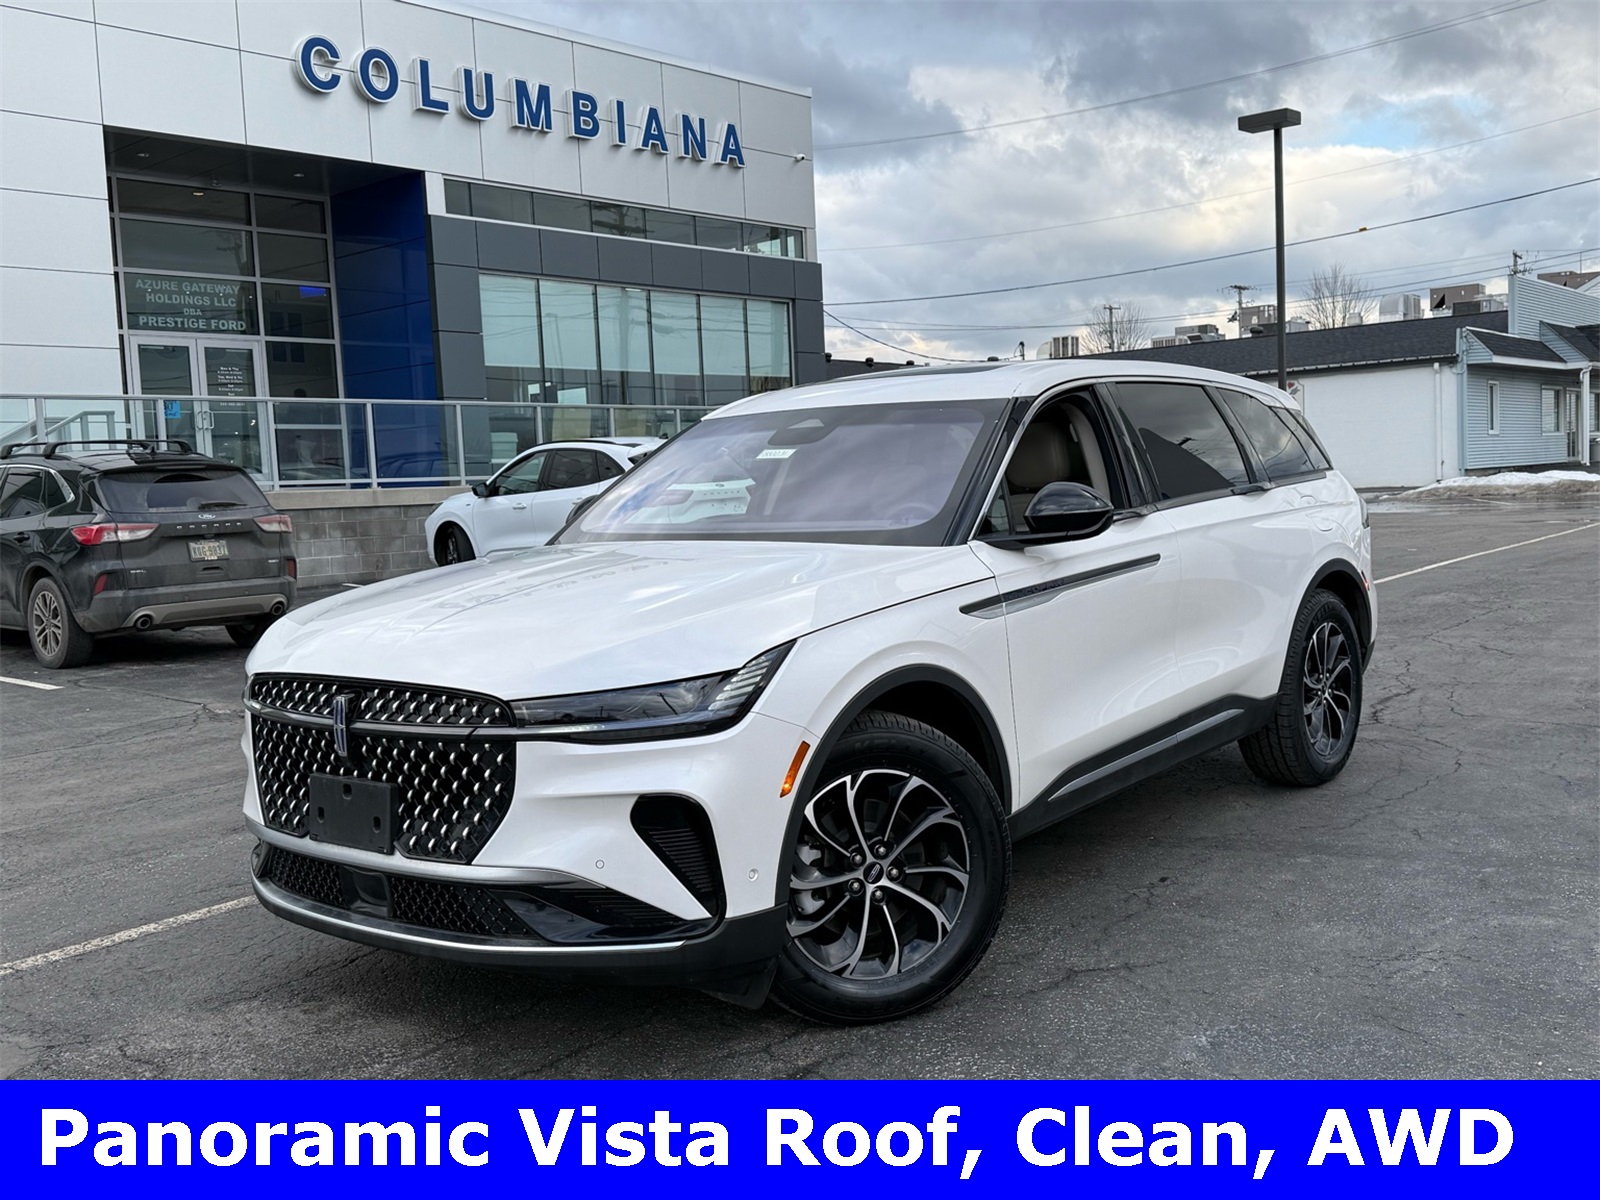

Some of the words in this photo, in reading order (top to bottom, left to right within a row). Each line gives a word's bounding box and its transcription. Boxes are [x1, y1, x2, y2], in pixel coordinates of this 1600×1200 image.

[295, 34, 747, 168] COLUMBIANA
[135, 279, 179, 292] AZURE
[182, 282, 240, 295] GATEWAY
[146, 293, 211, 306] HOLDINGS
[214, 297, 237, 307] LLC
[183, 308, 203, 316] DBA
[139, 316, 208, 330] PRESTIGE
[211, 319, 247, 331] FORD
